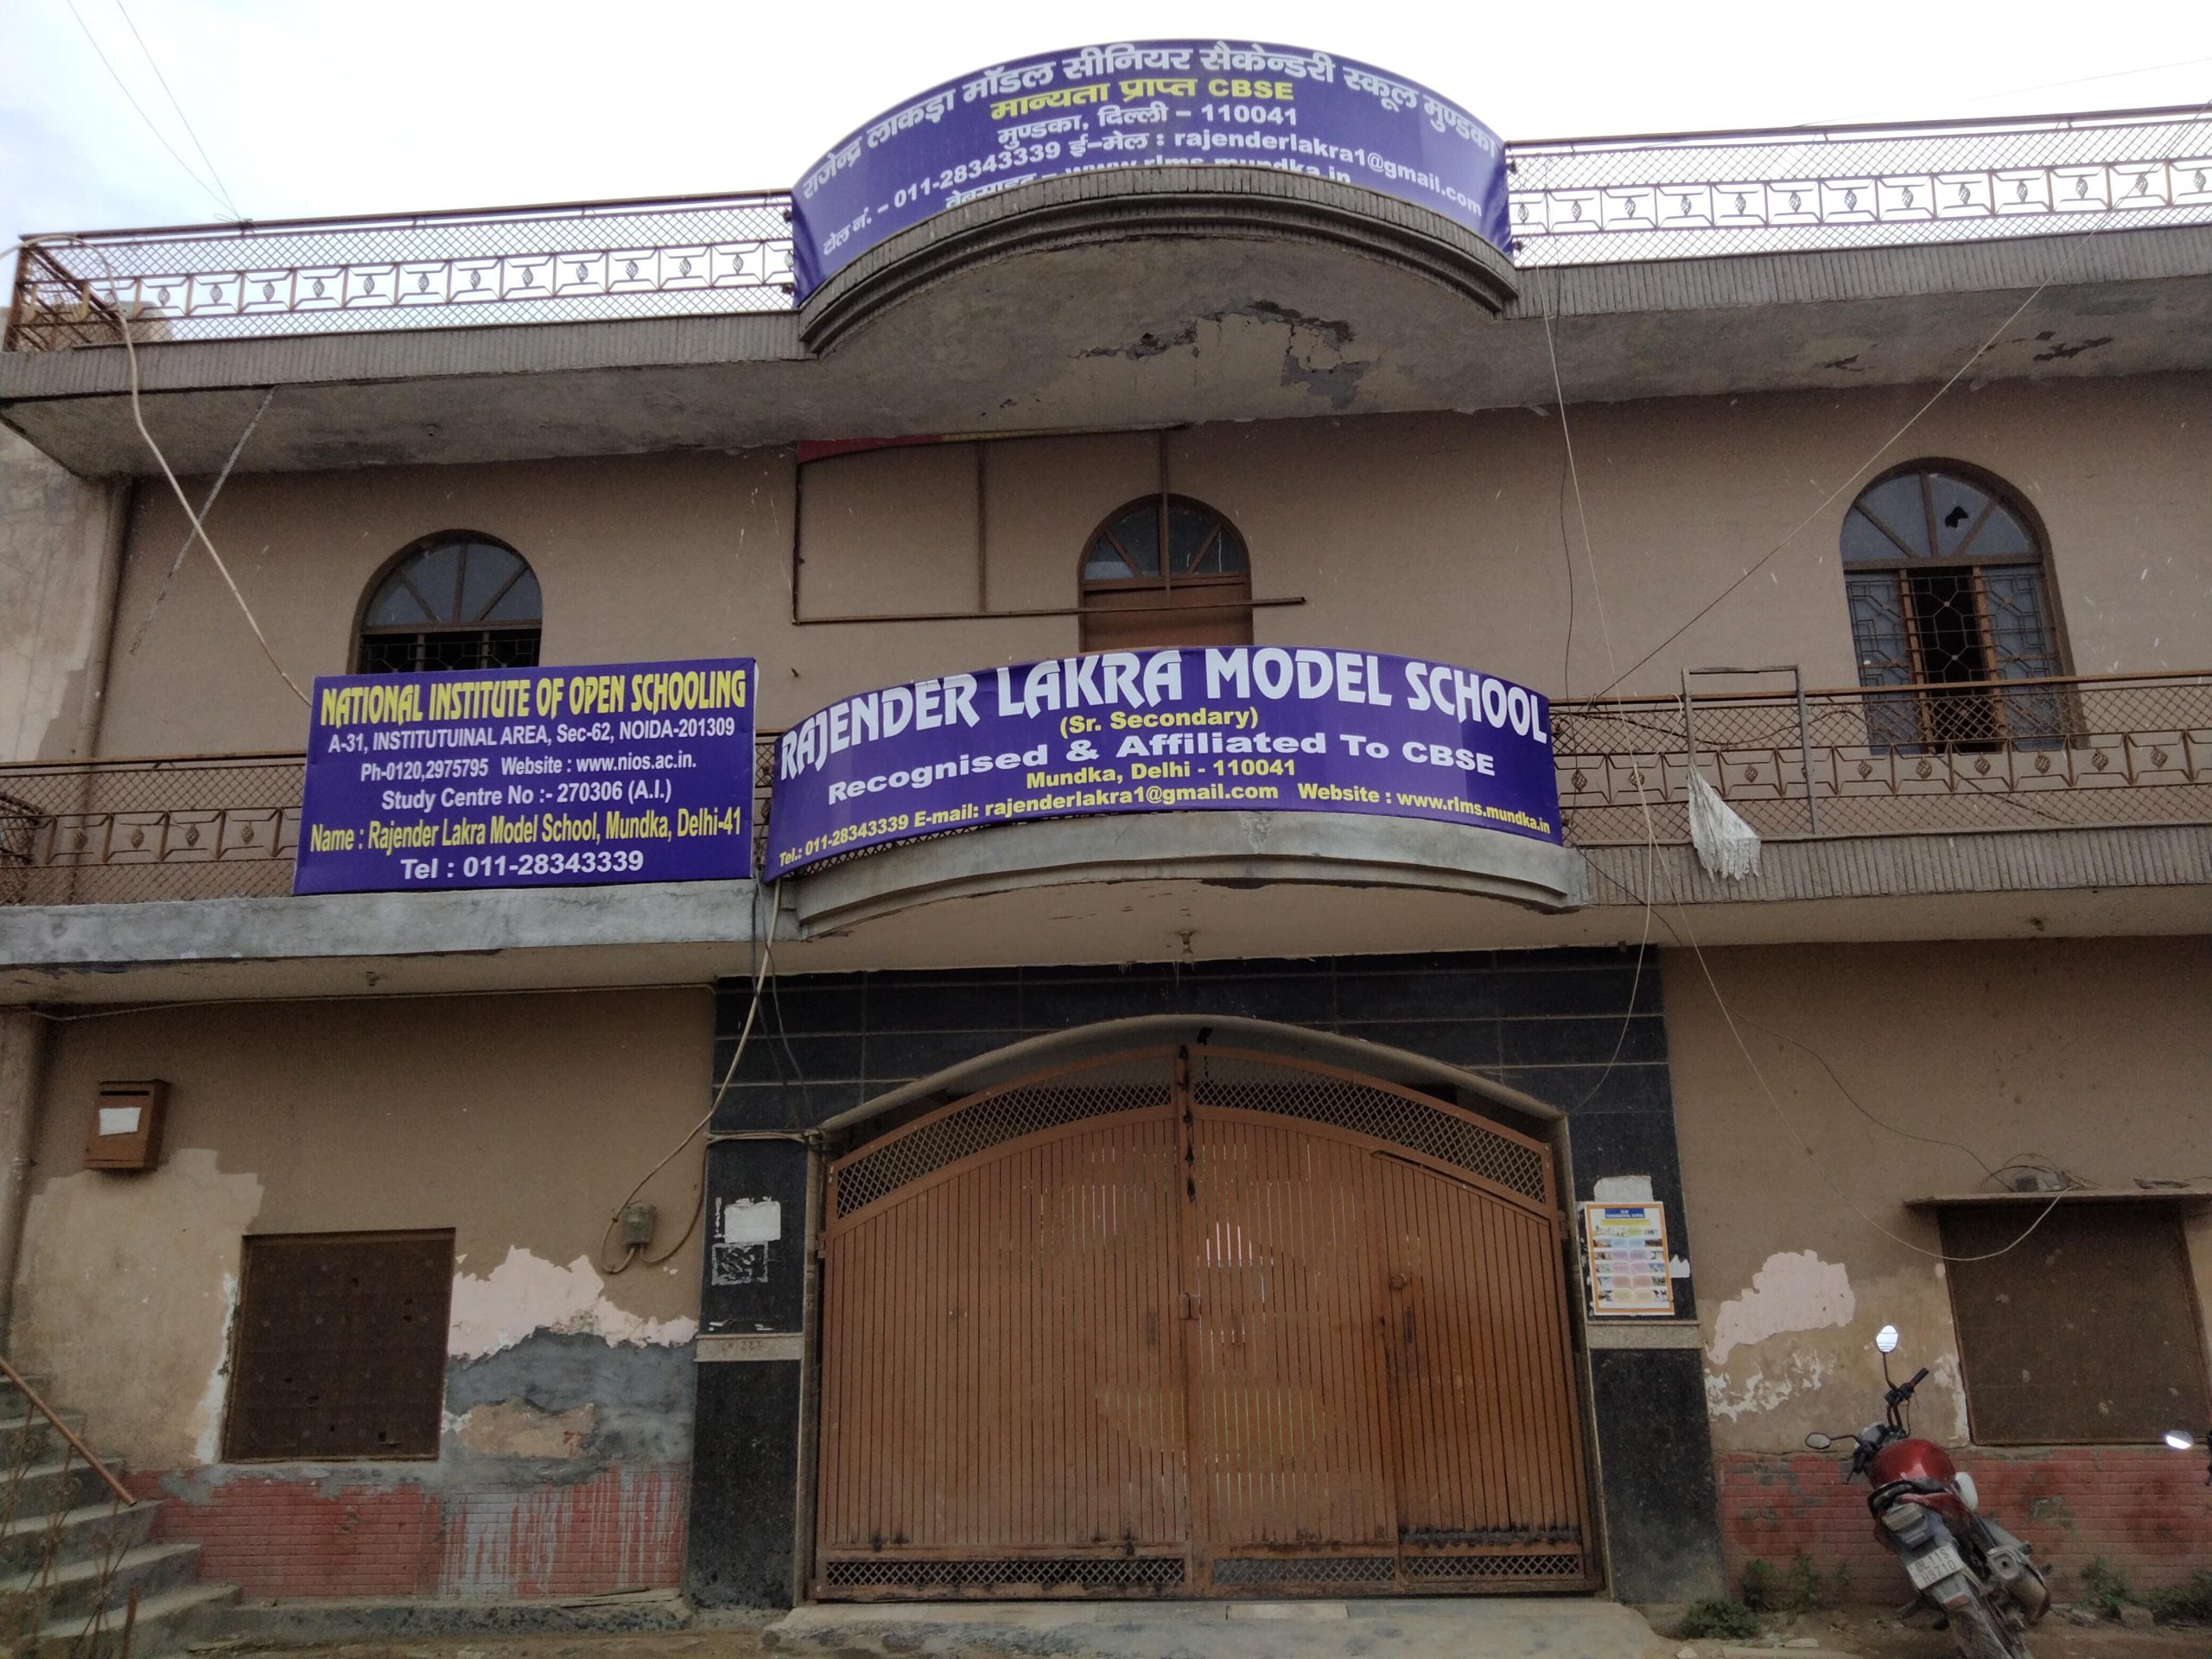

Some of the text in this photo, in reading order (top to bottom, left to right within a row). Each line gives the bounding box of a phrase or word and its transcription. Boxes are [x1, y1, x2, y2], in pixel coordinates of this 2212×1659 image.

[867, 89, 957, 148] लाकड़ा
[962, 62, 1056, 103] मॉडल
[1062, 42, 1193, 79] सीनियर
[1343, 66, 1419, 112] स्कूल
[1422, 93, 1497, 158] मुण्डका
[989, 78, 1294, 120] मान्यता प्राप्त CBSE
[1097, 101, 1169, 127] दिल्ली
[1201, 103, 1297, 125] 110041
[893, 141, 1061, 208] 011-28343339
[1175, 129, 1483, 217] rajenderlakra1@gmail.com
[321, 670, 746, 729] NATIONAL INSTITUTE OF OPEN SCHOOLING
[780, 647, 1548, 781] RAJENDER LAKRA MODEL SCHOOL
[328, 717, 735, 754] A-31, INSTITUTUINAL AREA, Sec-62, NOIDA-201309
[1059, 707, 1259, 739] (Sr. Secondary)
[360, 758, 489, 783] Ph-0120,2975795
[501, 754, 563, 776] Website
[575, 750, 697, 772] www.nios.ac.in.
[828, 732, 1496, 805] Recognised & Affiliated To CBSE
[1026, 767, 1123, 790] Mundka,
[1130, 760, 1190, 779] Delhi
[1213, 759, 1296, 777] 110041
[382, 790, 435, 813] Study
[441, 787, 503, 808] Centre
[507, 785, 534, 804] No
[556, 781, 623, 803] 270306
[627, 779, 671, 805] (A.I.)
[310, 823, 355, 853] Name
[367, 820, 440, 856] Rajender
[442, 817, 486, 847] Lakra
[489, 814, 539, 845] Model
[542, 811, 601, 846] School,
[605, 809, 672, 842] Mundka,
[677, 806, 741, 837] Delhi-41
[804, 815, 909, 856] 011-28343339
[914, 803, 980, 829] E-mail:
[985, 783, 1279, 818] rajenderlakra1@gmail.com
[1298, 782, 1380, 804] Website
[1396, 792, 1551, 835] www.rlms.mundka.in
[400, 858, 438, 880] Tel
[463, 849, 645, 878] 011-28343339
